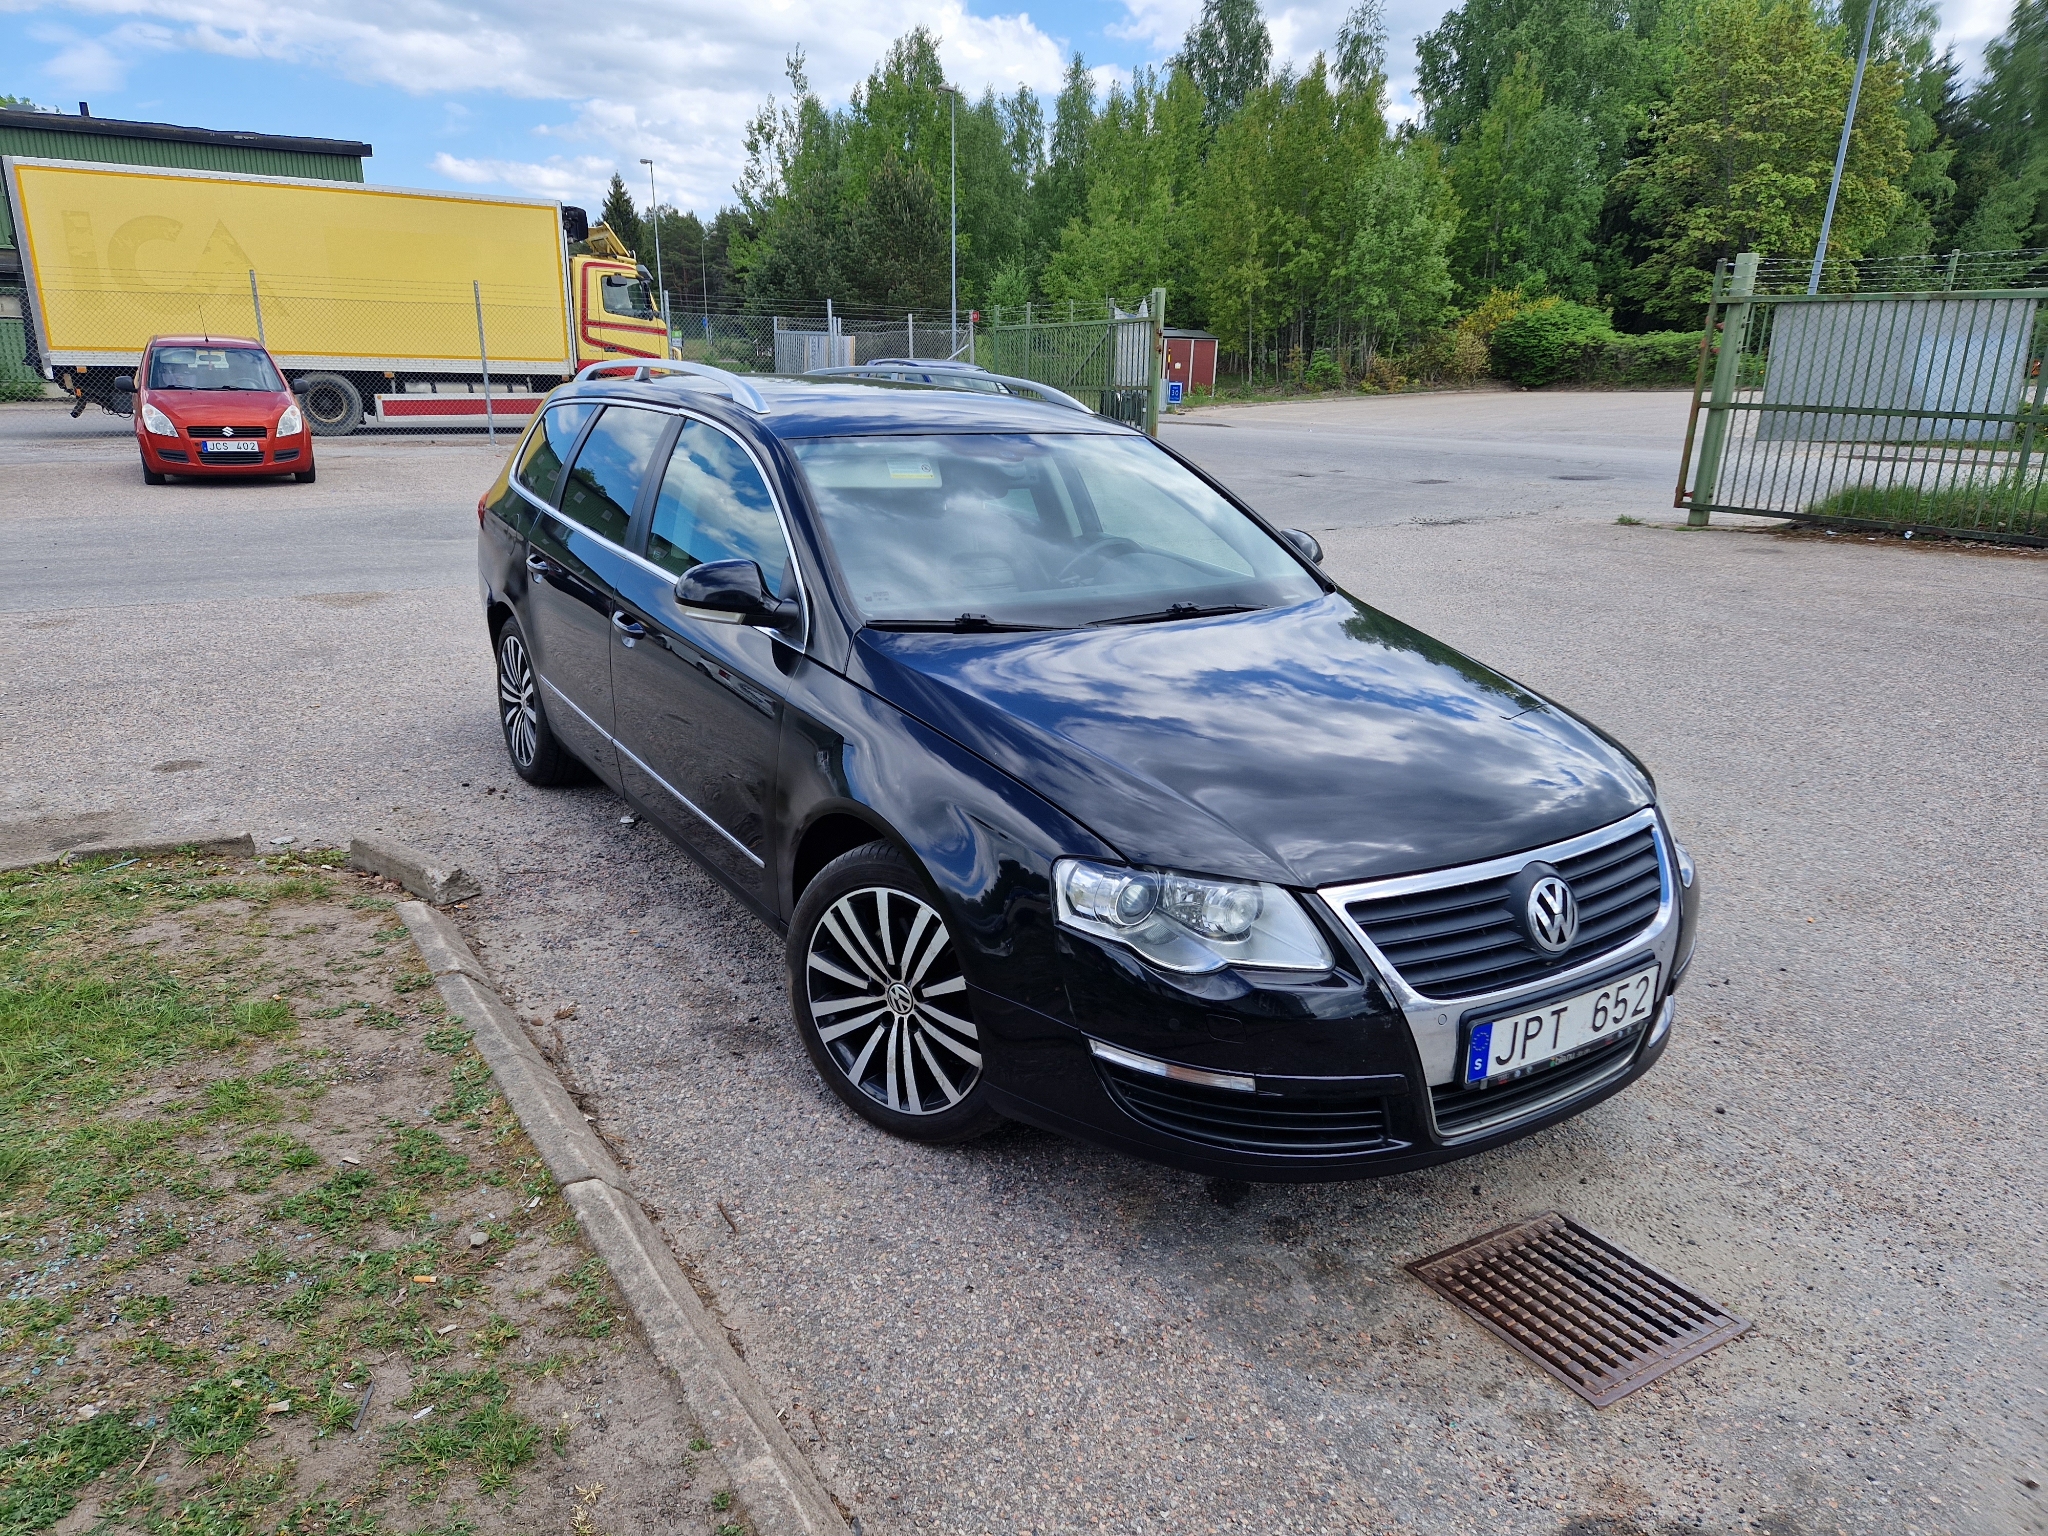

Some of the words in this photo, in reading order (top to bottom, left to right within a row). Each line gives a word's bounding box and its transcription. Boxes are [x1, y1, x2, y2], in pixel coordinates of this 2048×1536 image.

[61, 209, 290, 318] ICA
[209, 442, 229, 450] JCS
[236, 442, 256, 450] 402
[1474, 1057, 1483, 1071] S
[1495, 1006, 1569, 1066] JPT
[1591, 975, 1650, 1033] 652
